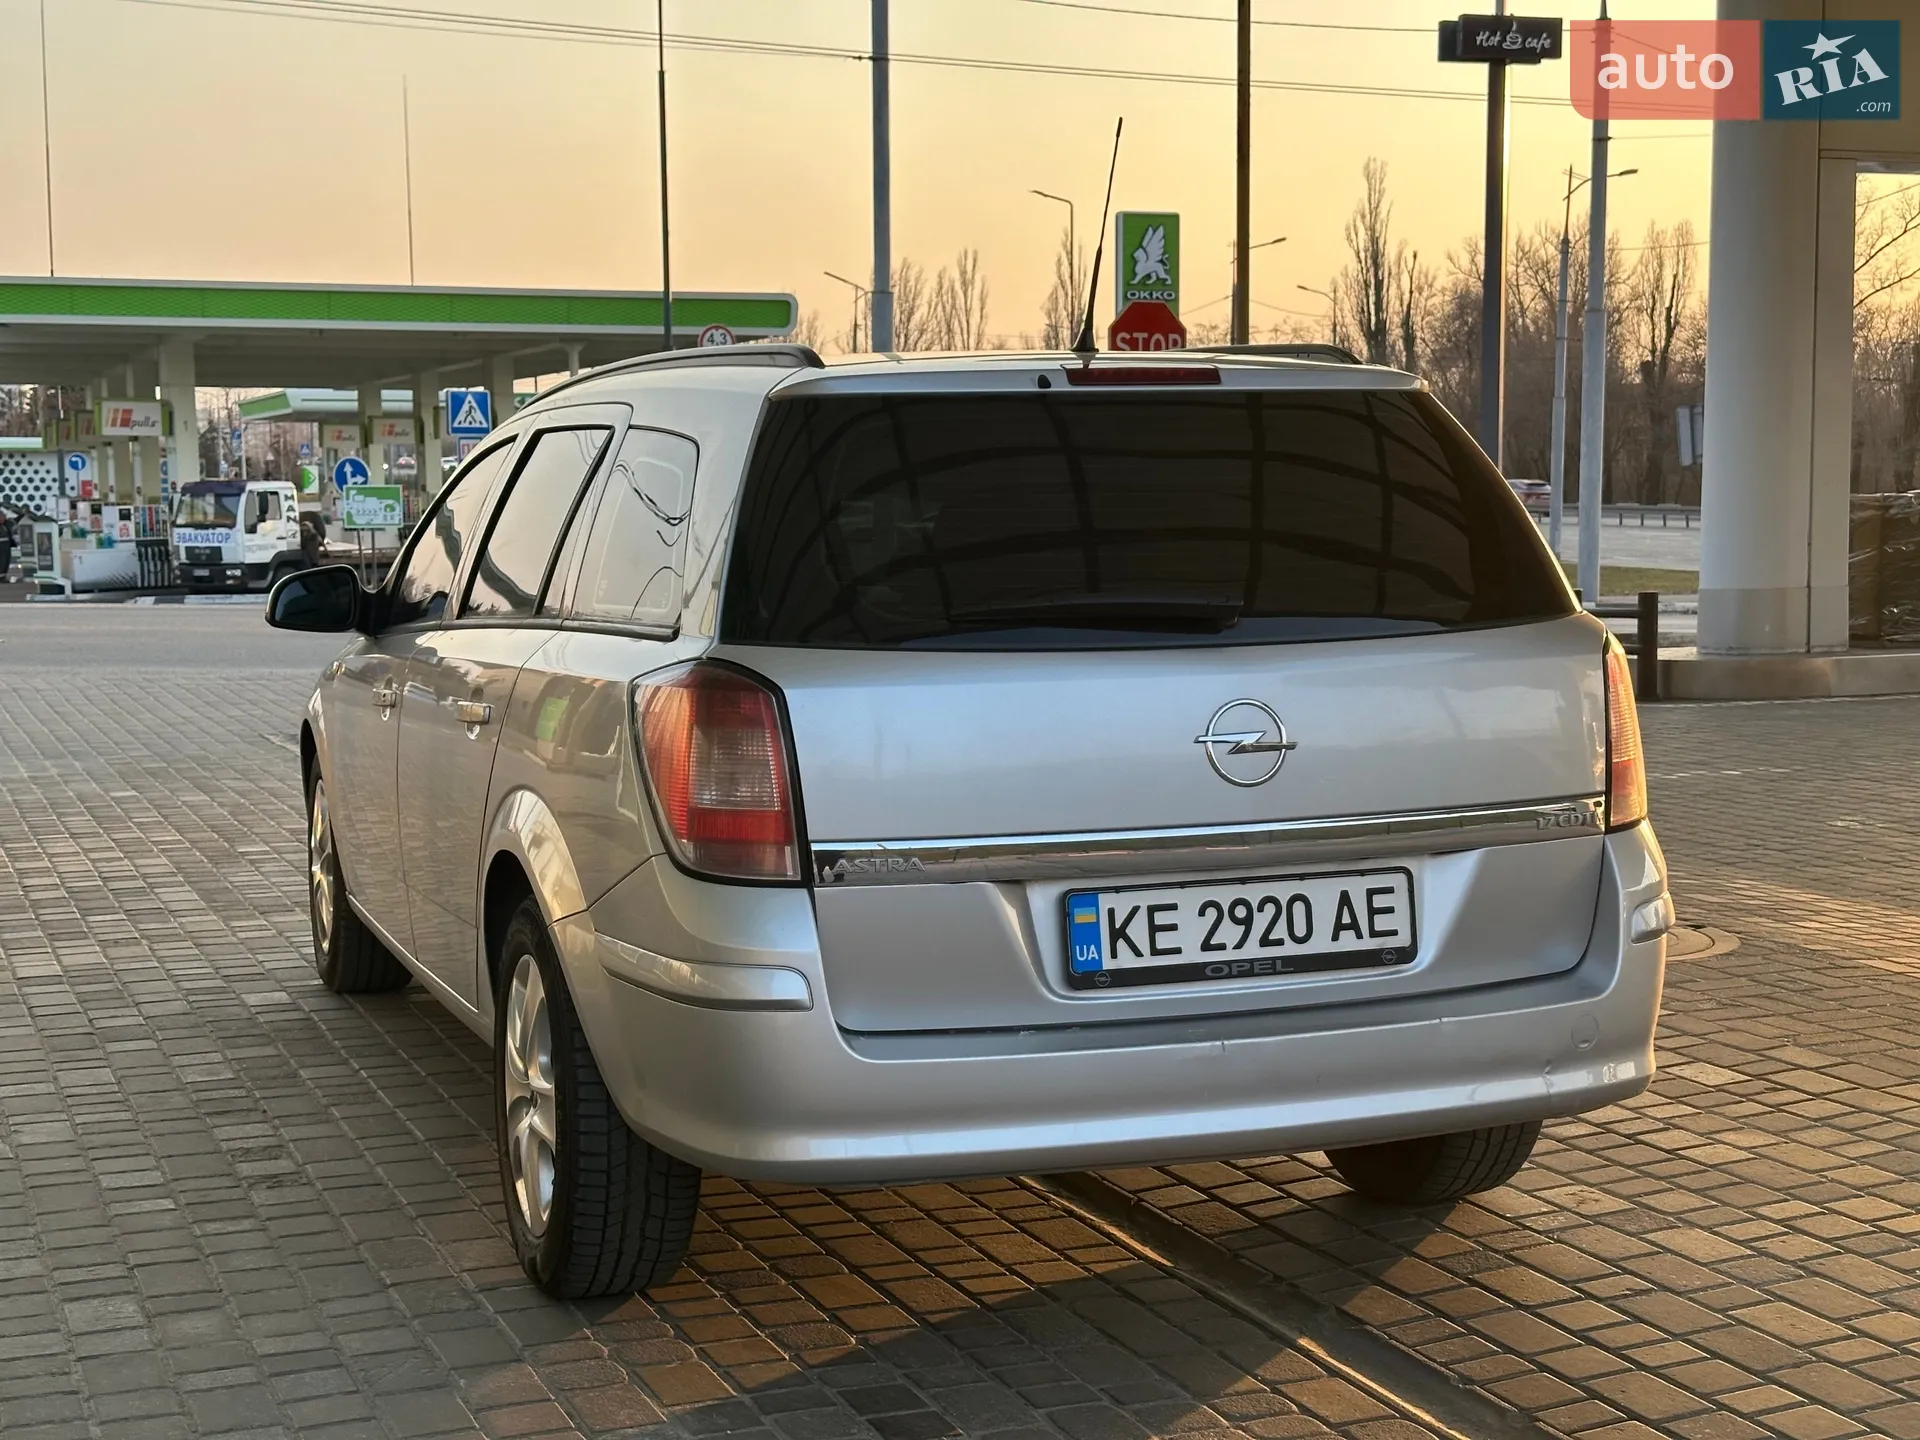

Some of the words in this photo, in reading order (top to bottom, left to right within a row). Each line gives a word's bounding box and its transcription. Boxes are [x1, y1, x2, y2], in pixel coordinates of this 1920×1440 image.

[1475, 30, 1501, 47] Hot
[1525, 32, 1551, 53] cafe
[1126, 290, 1175, 300] OKKO
[1115, 331, 1182, 351] STOP
[175, 532, 231, 544] ЭВАКУАТОР
[831, 857, 926, 873] ASTRA
[1107, 903, 1183, 959] KE
[1197, 893, 1314, 952] 2920
[1331, 886, 1399, 942] AE
[1076, 944, 1099, 961] UA
[1204, 959, 1294, 977] OPEL
